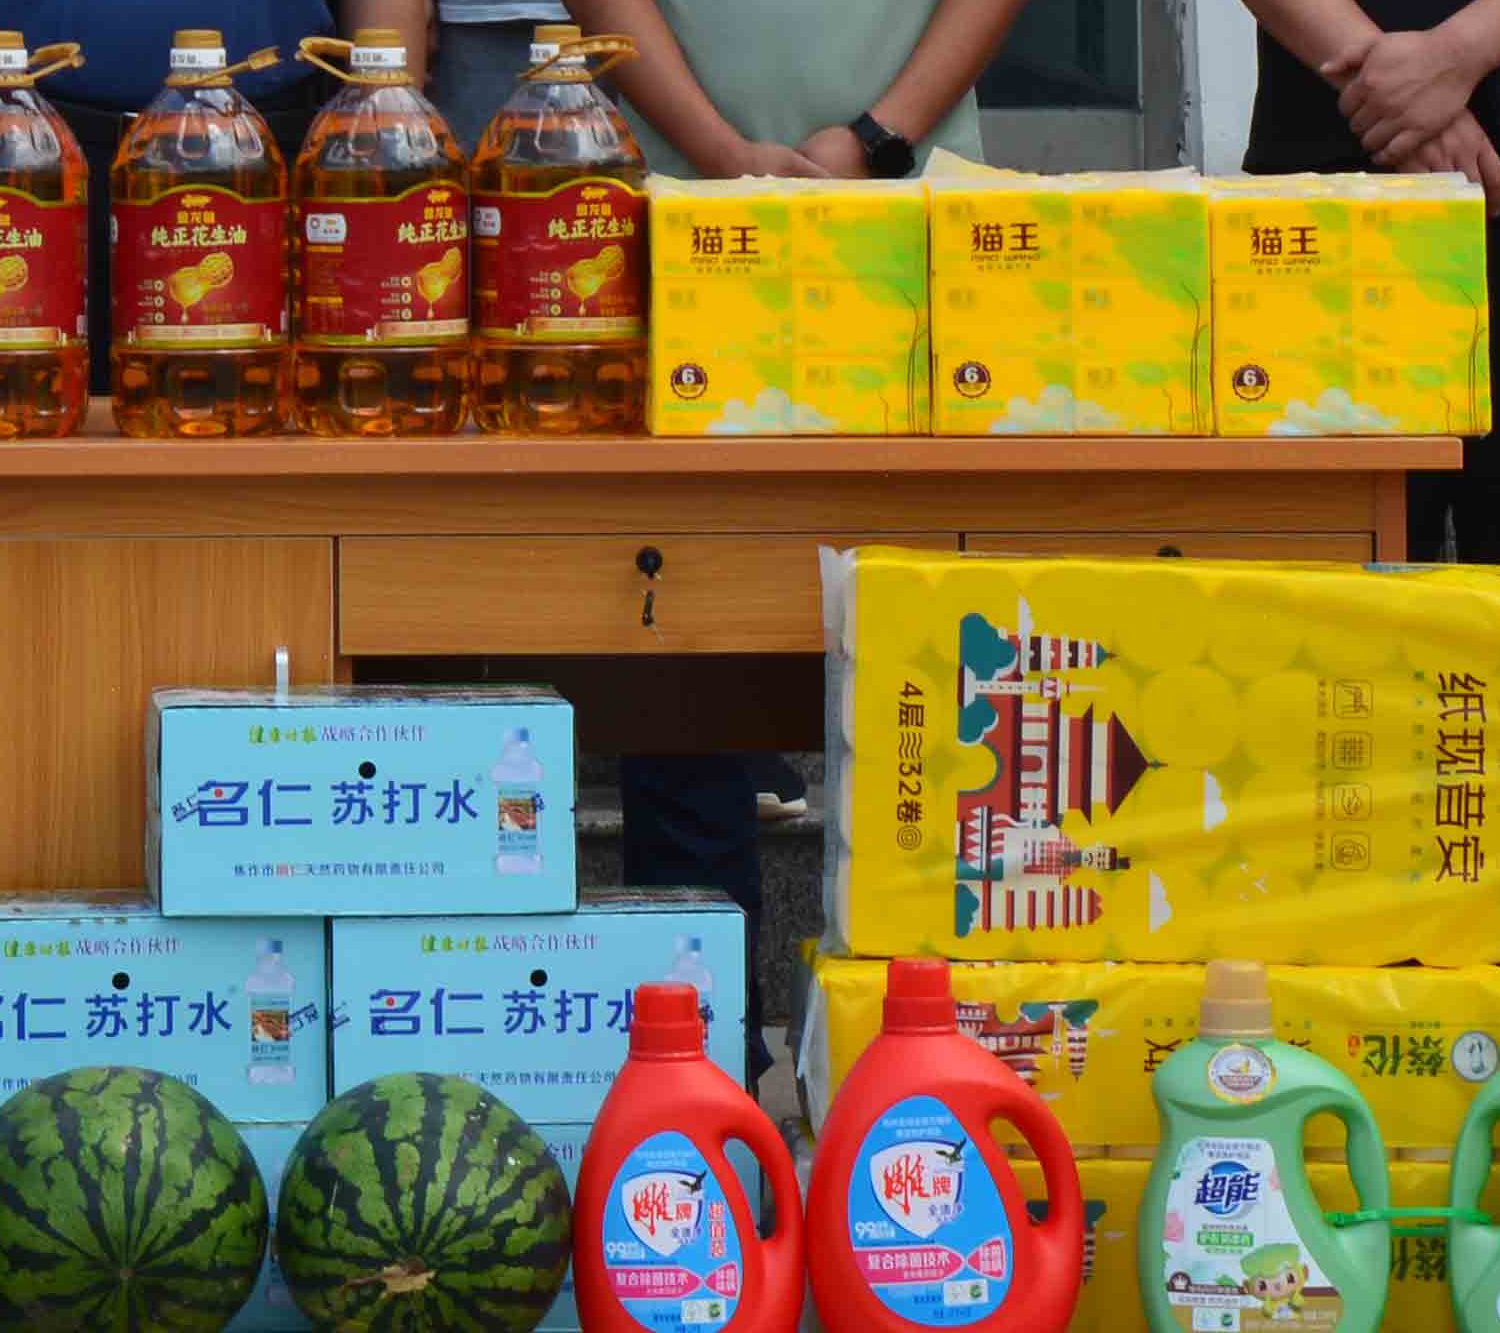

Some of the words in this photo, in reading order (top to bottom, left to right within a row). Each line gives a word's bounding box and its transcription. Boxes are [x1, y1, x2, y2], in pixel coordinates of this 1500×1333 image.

[151, 226, 247, 247] 纯正花生油
[549, 219, 634, 239] 纯正花生油
[691, 225, 760, 255] 猫王
[972, 222, 1040, 252] 猫王
[1250, 226, 1319, 256] 猫王
[682, 369, 694, 384] 6
[965, 367, 978, 382] 6
[1243, 371, 1257, 385] 6
[899, 682, 924, 727] 4层
[198, 779, 312, 826] 名仁
[331, 779, 479, 825] 苏打水
[897, 763, 923, 824] 32卷
[85, 990, 233, 1038] 苏打水
[369, 988, 484, 1036] 名仁
[1196, 1173, 1259, 1208] 超能
